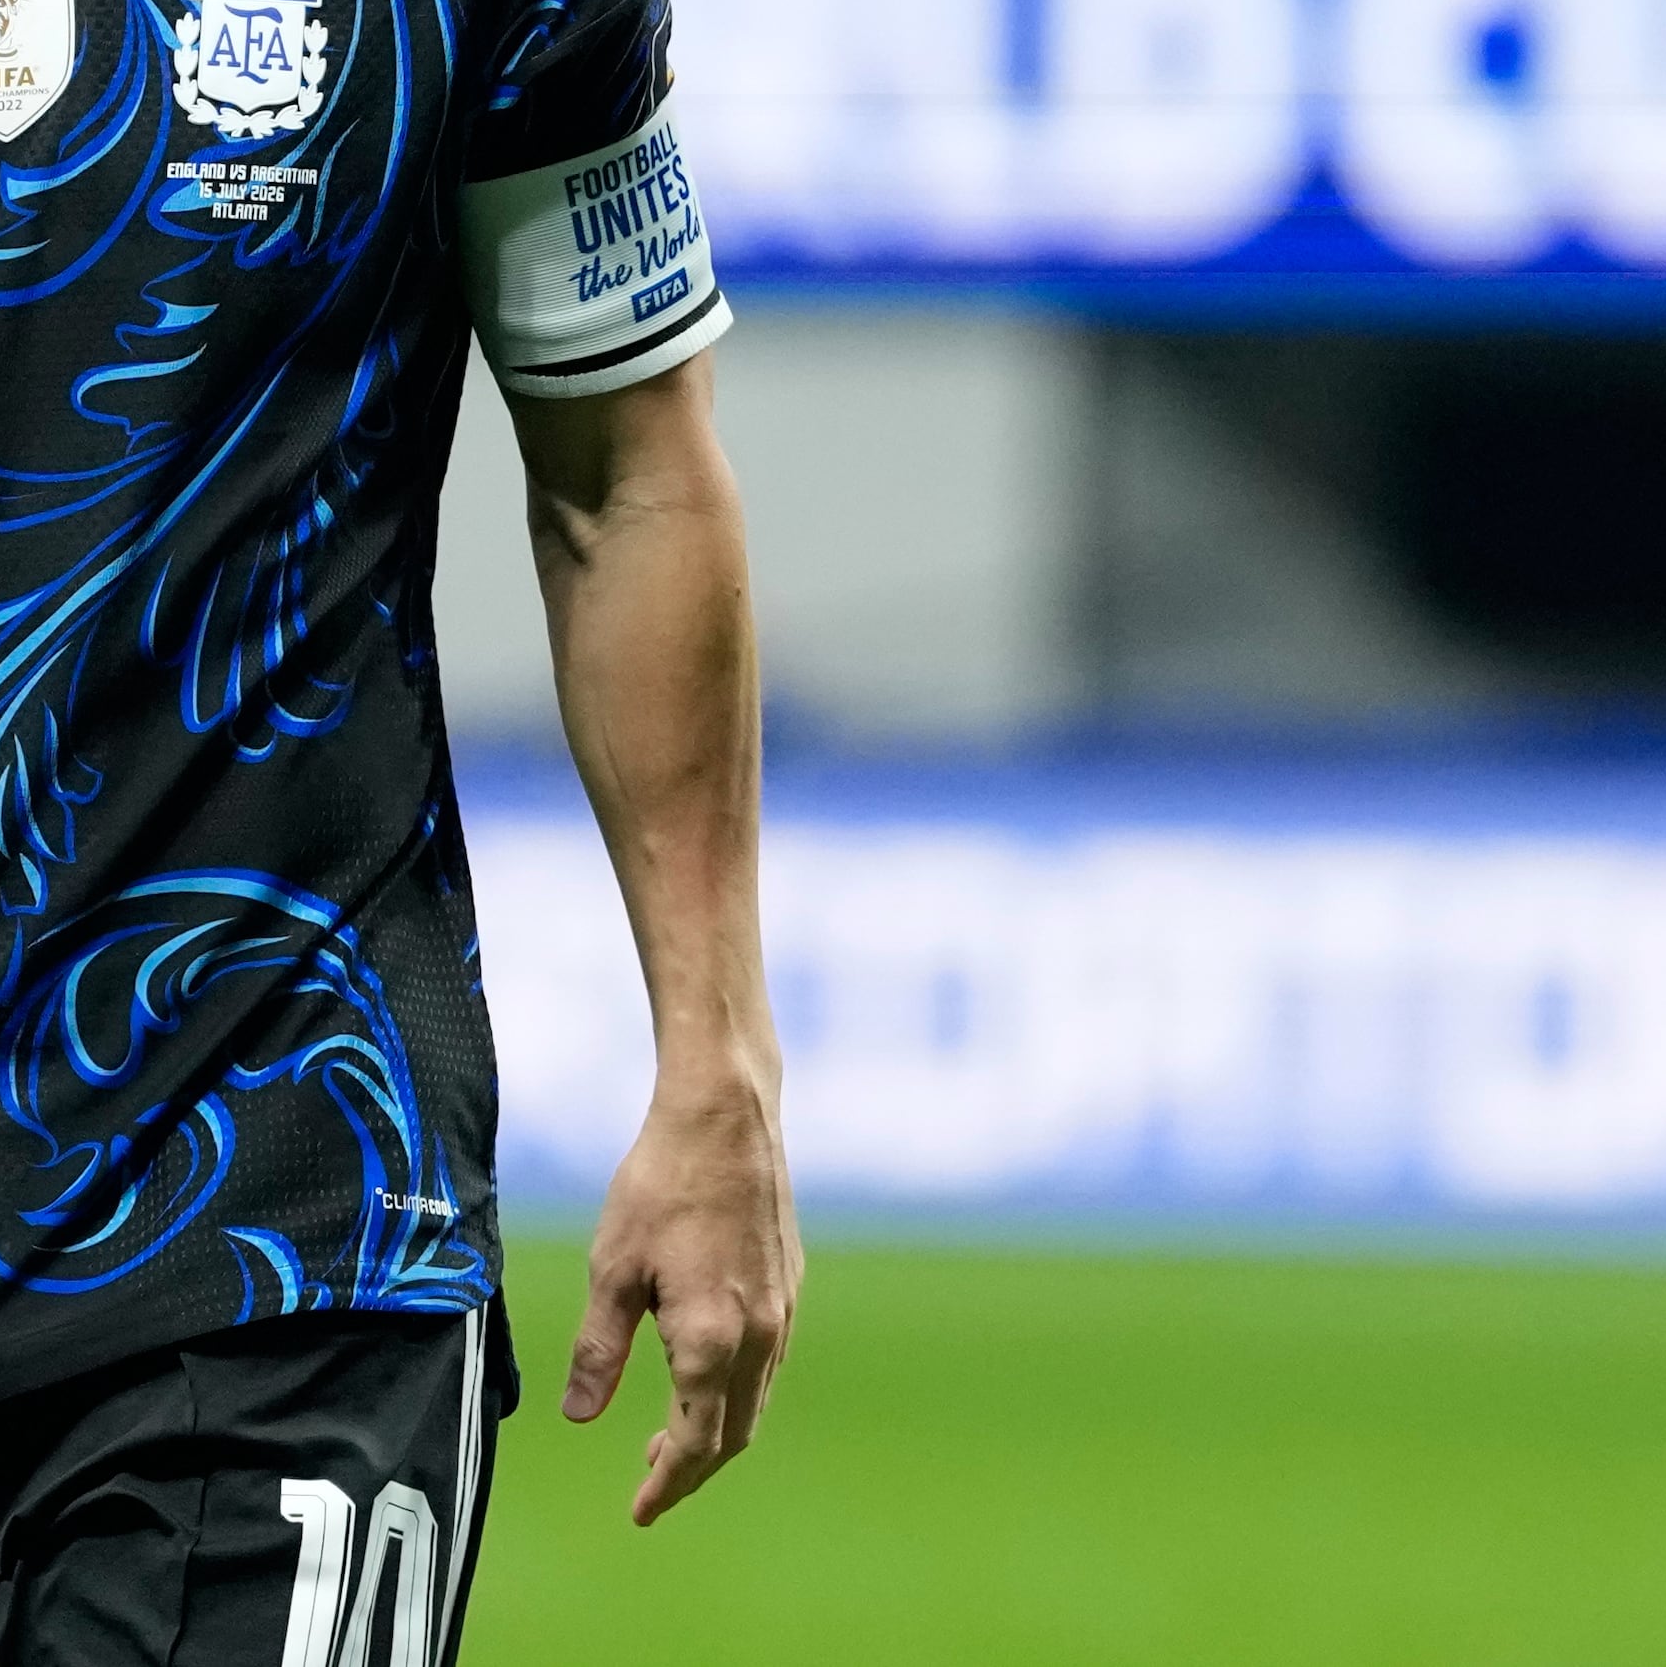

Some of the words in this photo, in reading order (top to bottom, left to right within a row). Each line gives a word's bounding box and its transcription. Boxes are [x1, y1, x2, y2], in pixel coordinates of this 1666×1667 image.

[207, 3, 293, 85] AFA
[167, 162, 226, 180] ENGLAND
[229, 164, 247, 181] VS
[250, 165, 318, 185] ARGENTINA
[199, 181, 213, 198] 15
[218, 182, 248, 201] JULY
[250, 185, 286, 202] 2026
[564, 121, 678, 209] FOOTBALL
[571, 154, 690, 254] UNITES
[212, 202, 269, 221] ATLANTA
[568, 255, 633, 302] the
[635, 197, 703, 278] World
[638, 276, 687, 316] FIFA
[281, 1478, 439, 1667] 10
